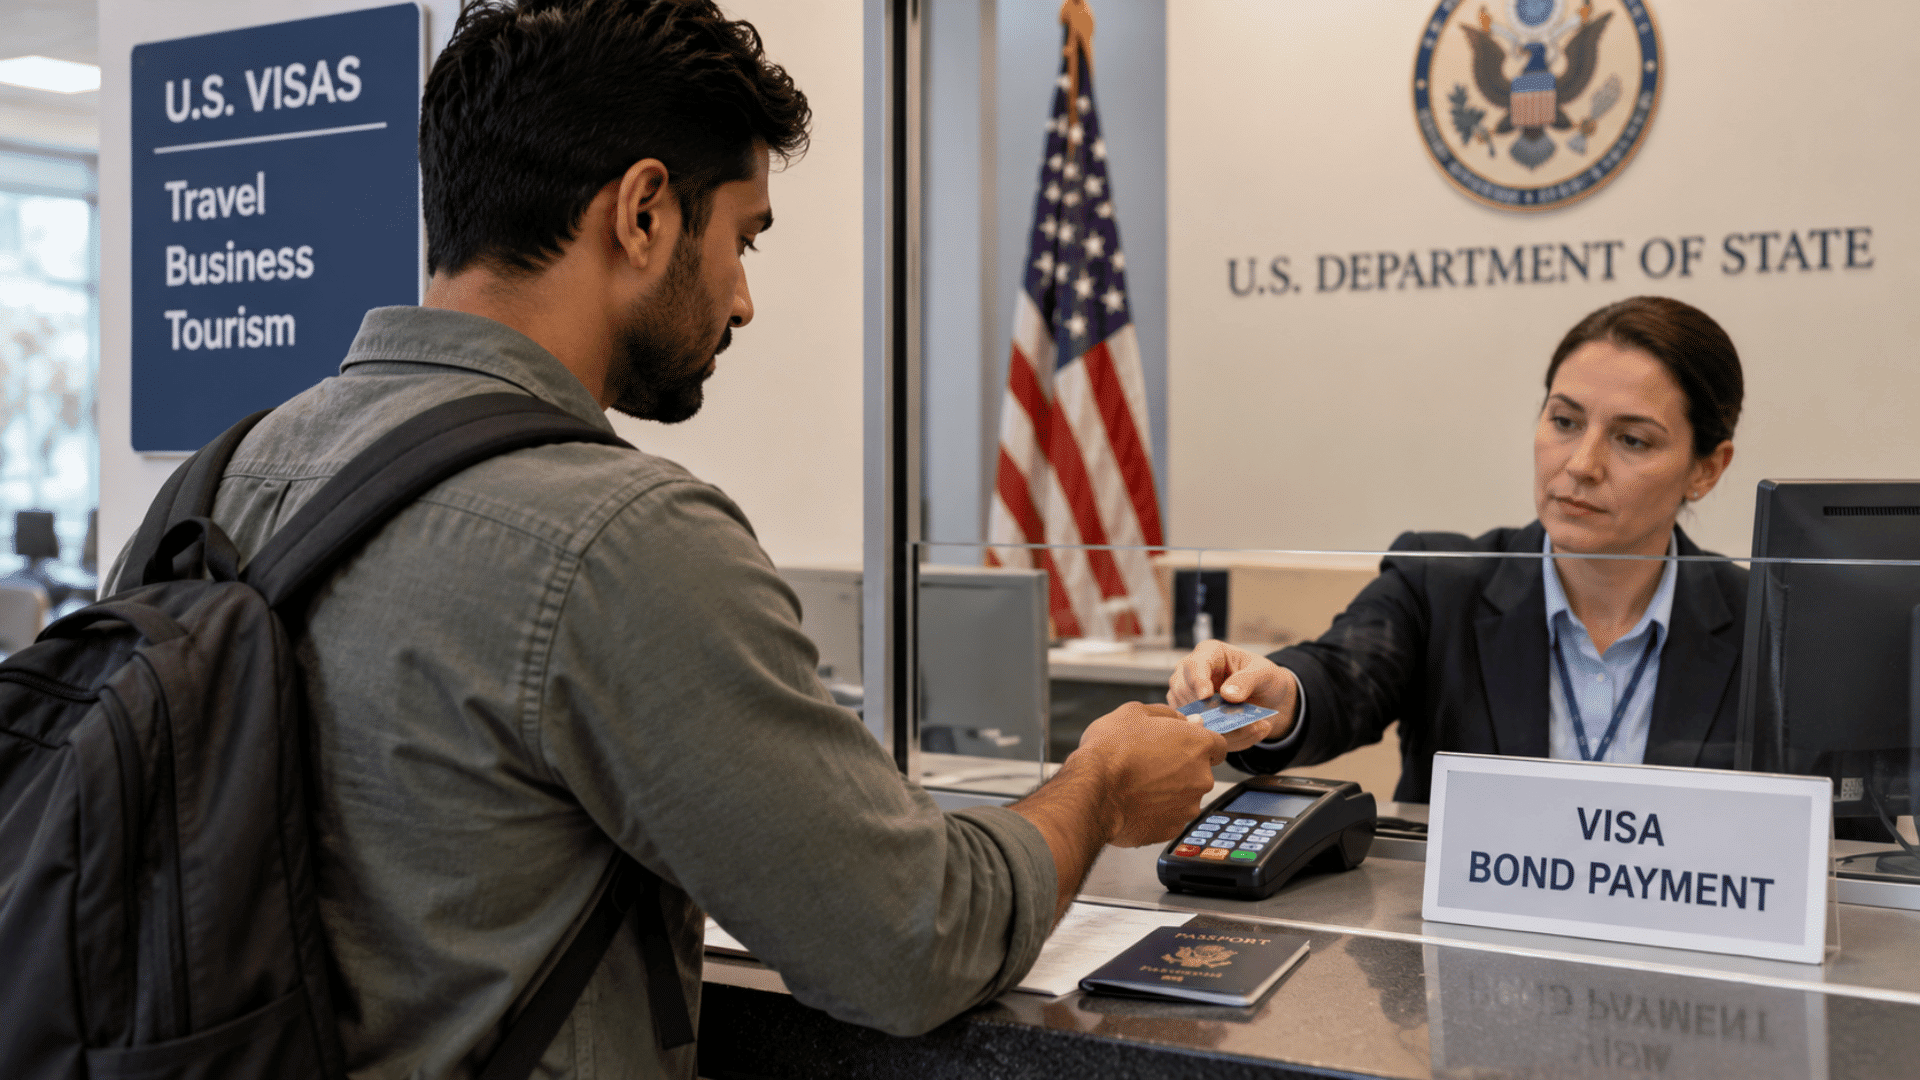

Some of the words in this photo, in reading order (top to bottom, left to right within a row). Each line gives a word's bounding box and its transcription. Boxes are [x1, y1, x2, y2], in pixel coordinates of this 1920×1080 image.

[165, 74, 234, 123] U.S.
[245, 55, 362, 112] VISAS
[165, 171, 266, 222] Travel
[166, 240, 314, 286] Business
[1226, 255, 1302, 297] U.S.
[1315, 240, 1625, 293] DEPARTMENT
[1639, 235, 1705, 278] OF
[1720, 227, 1875, 275] STATE
[164, 306, 296, 350] Tourism
[1577, 807, 1665, 847] VISA
[1468, 851, 1575, 891] BOND
[1588, 861, 1775, 912] PAYMENT
